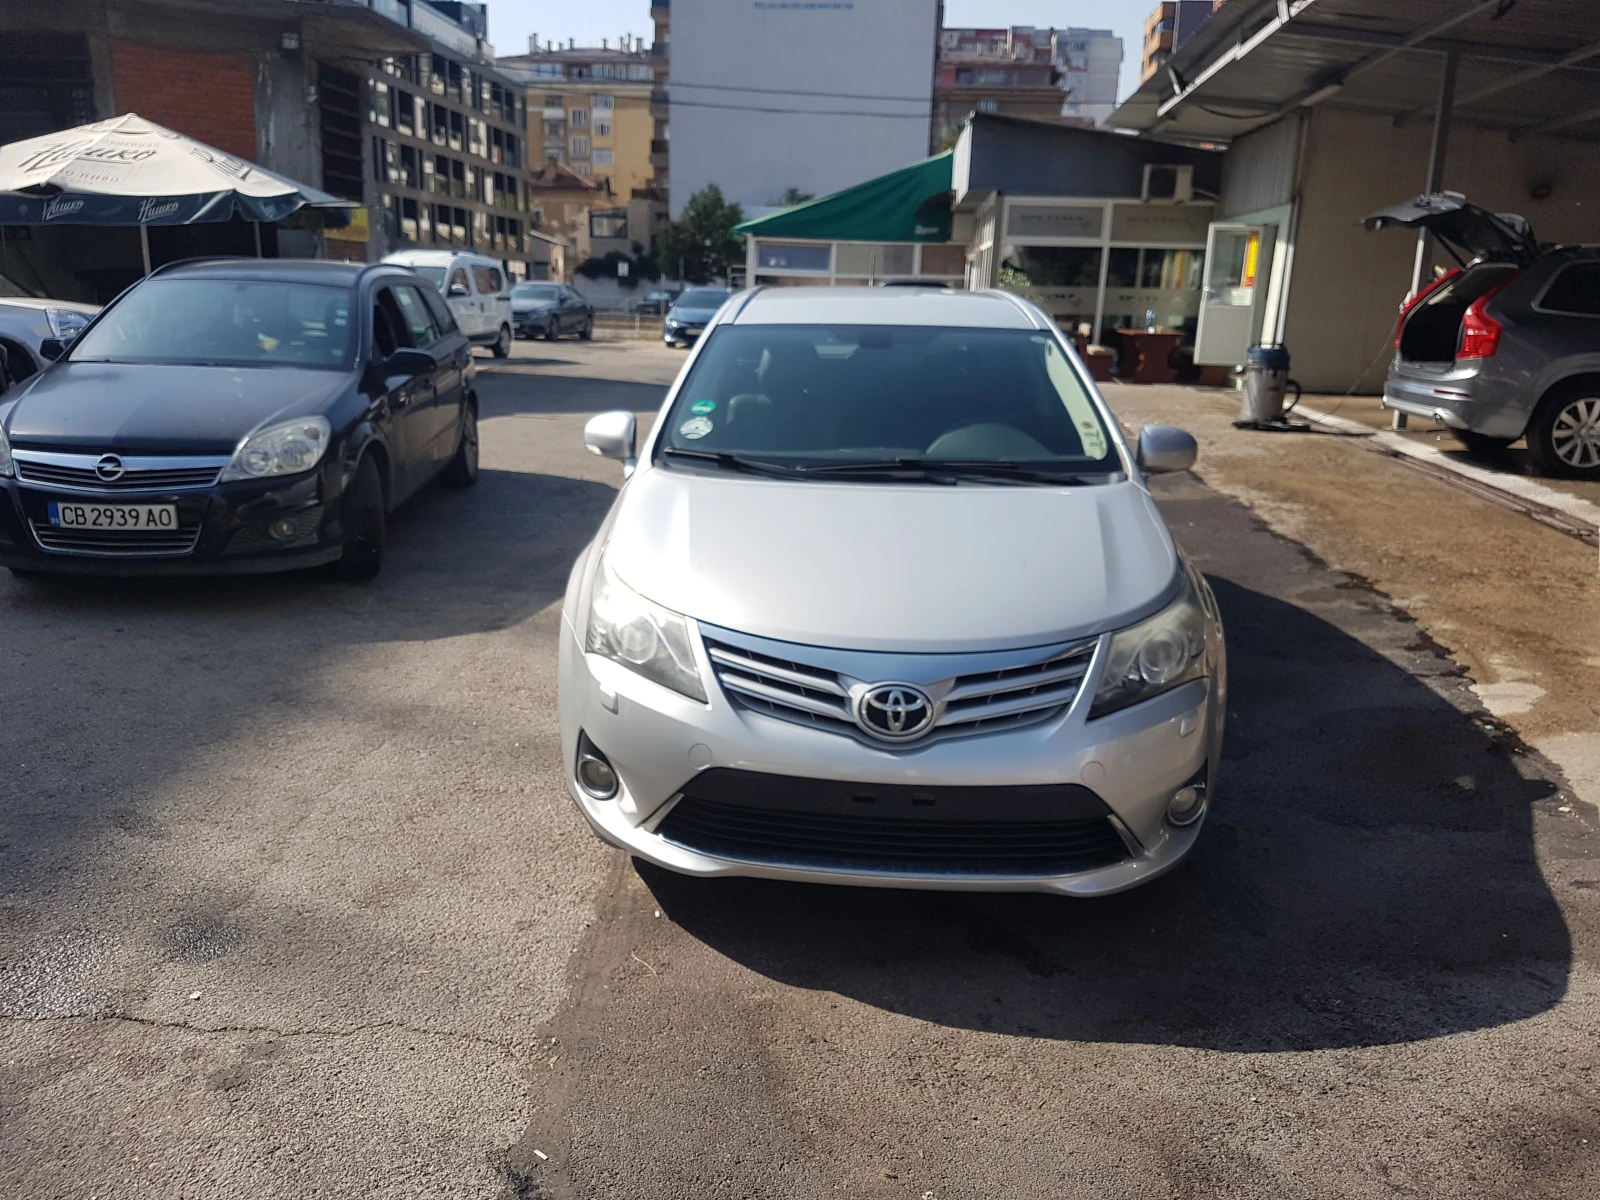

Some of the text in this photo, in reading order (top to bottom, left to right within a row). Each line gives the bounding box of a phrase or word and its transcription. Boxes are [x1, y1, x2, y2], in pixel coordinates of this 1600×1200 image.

[137, 197, 180, 224] Нишко
[61, 506, 87, 526] CB
[90, 507, 141, 527] 2939
[146, 508, 172, 527] AO
